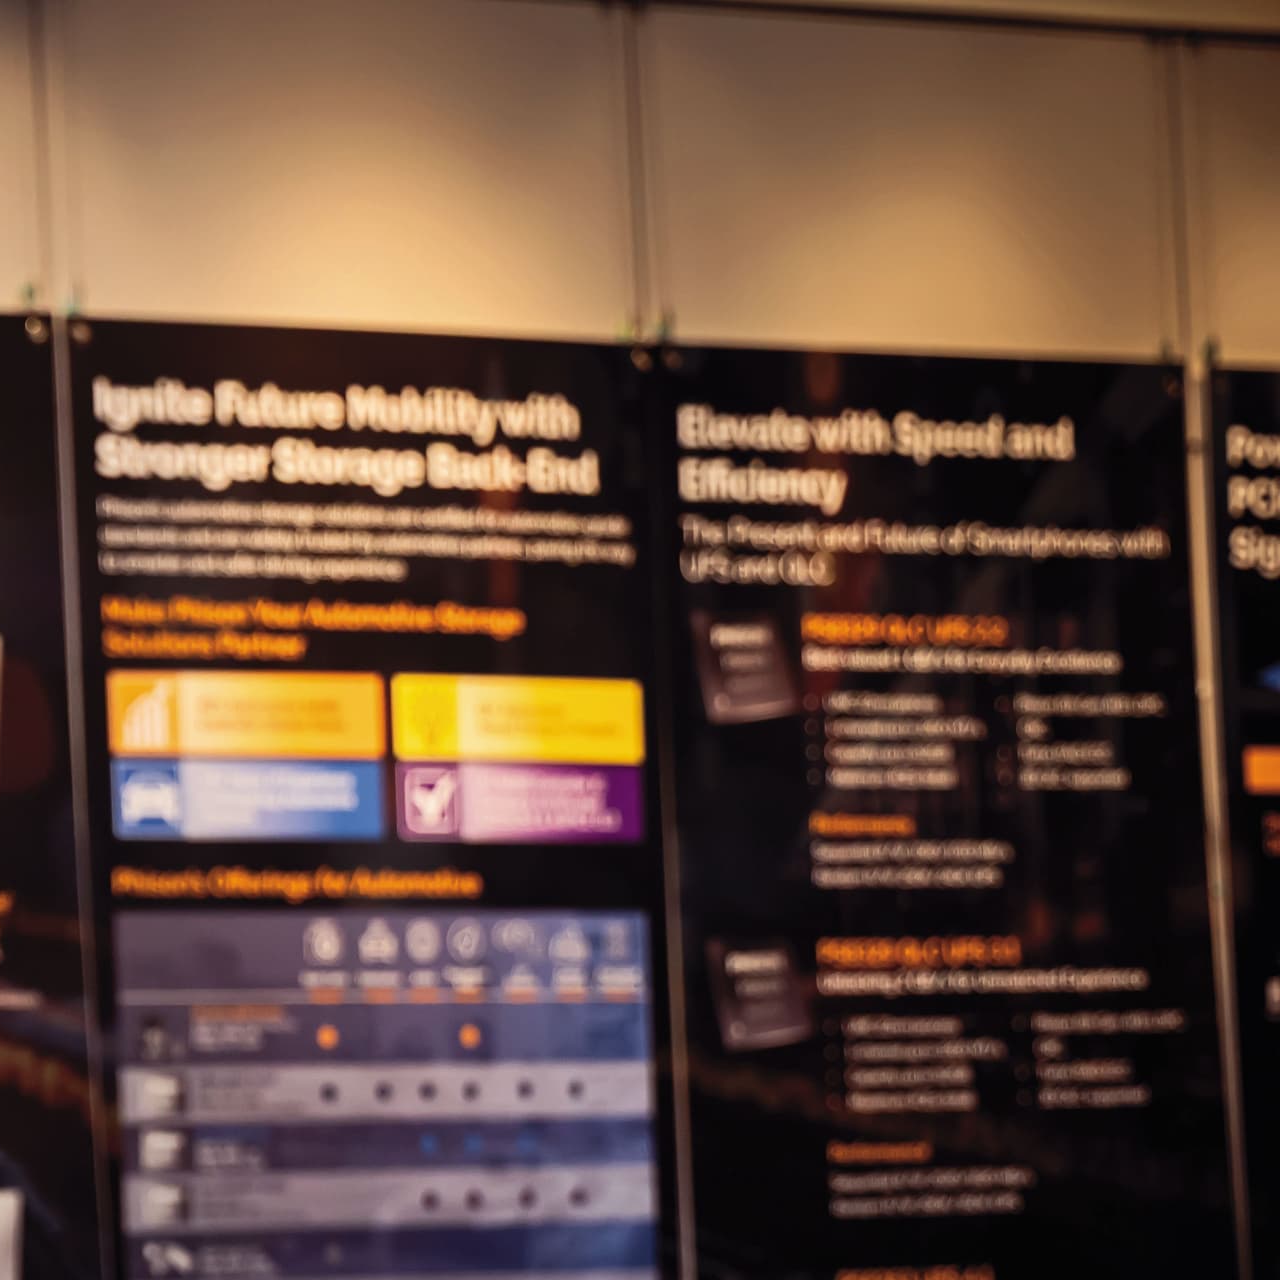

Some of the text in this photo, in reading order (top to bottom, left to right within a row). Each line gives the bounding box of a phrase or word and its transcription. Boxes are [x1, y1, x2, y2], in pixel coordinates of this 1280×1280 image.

[93, 375, 213, 434] Ignite
[214, 380, 344, 430] Future
[498, 393, 582, 442] with
[892, 410, 1003, 465] Speed
[94, 431, 271, 493] Stronger
[272, 437, 427, 497] Storage
[678, 455, 848, 516] Efficiency
